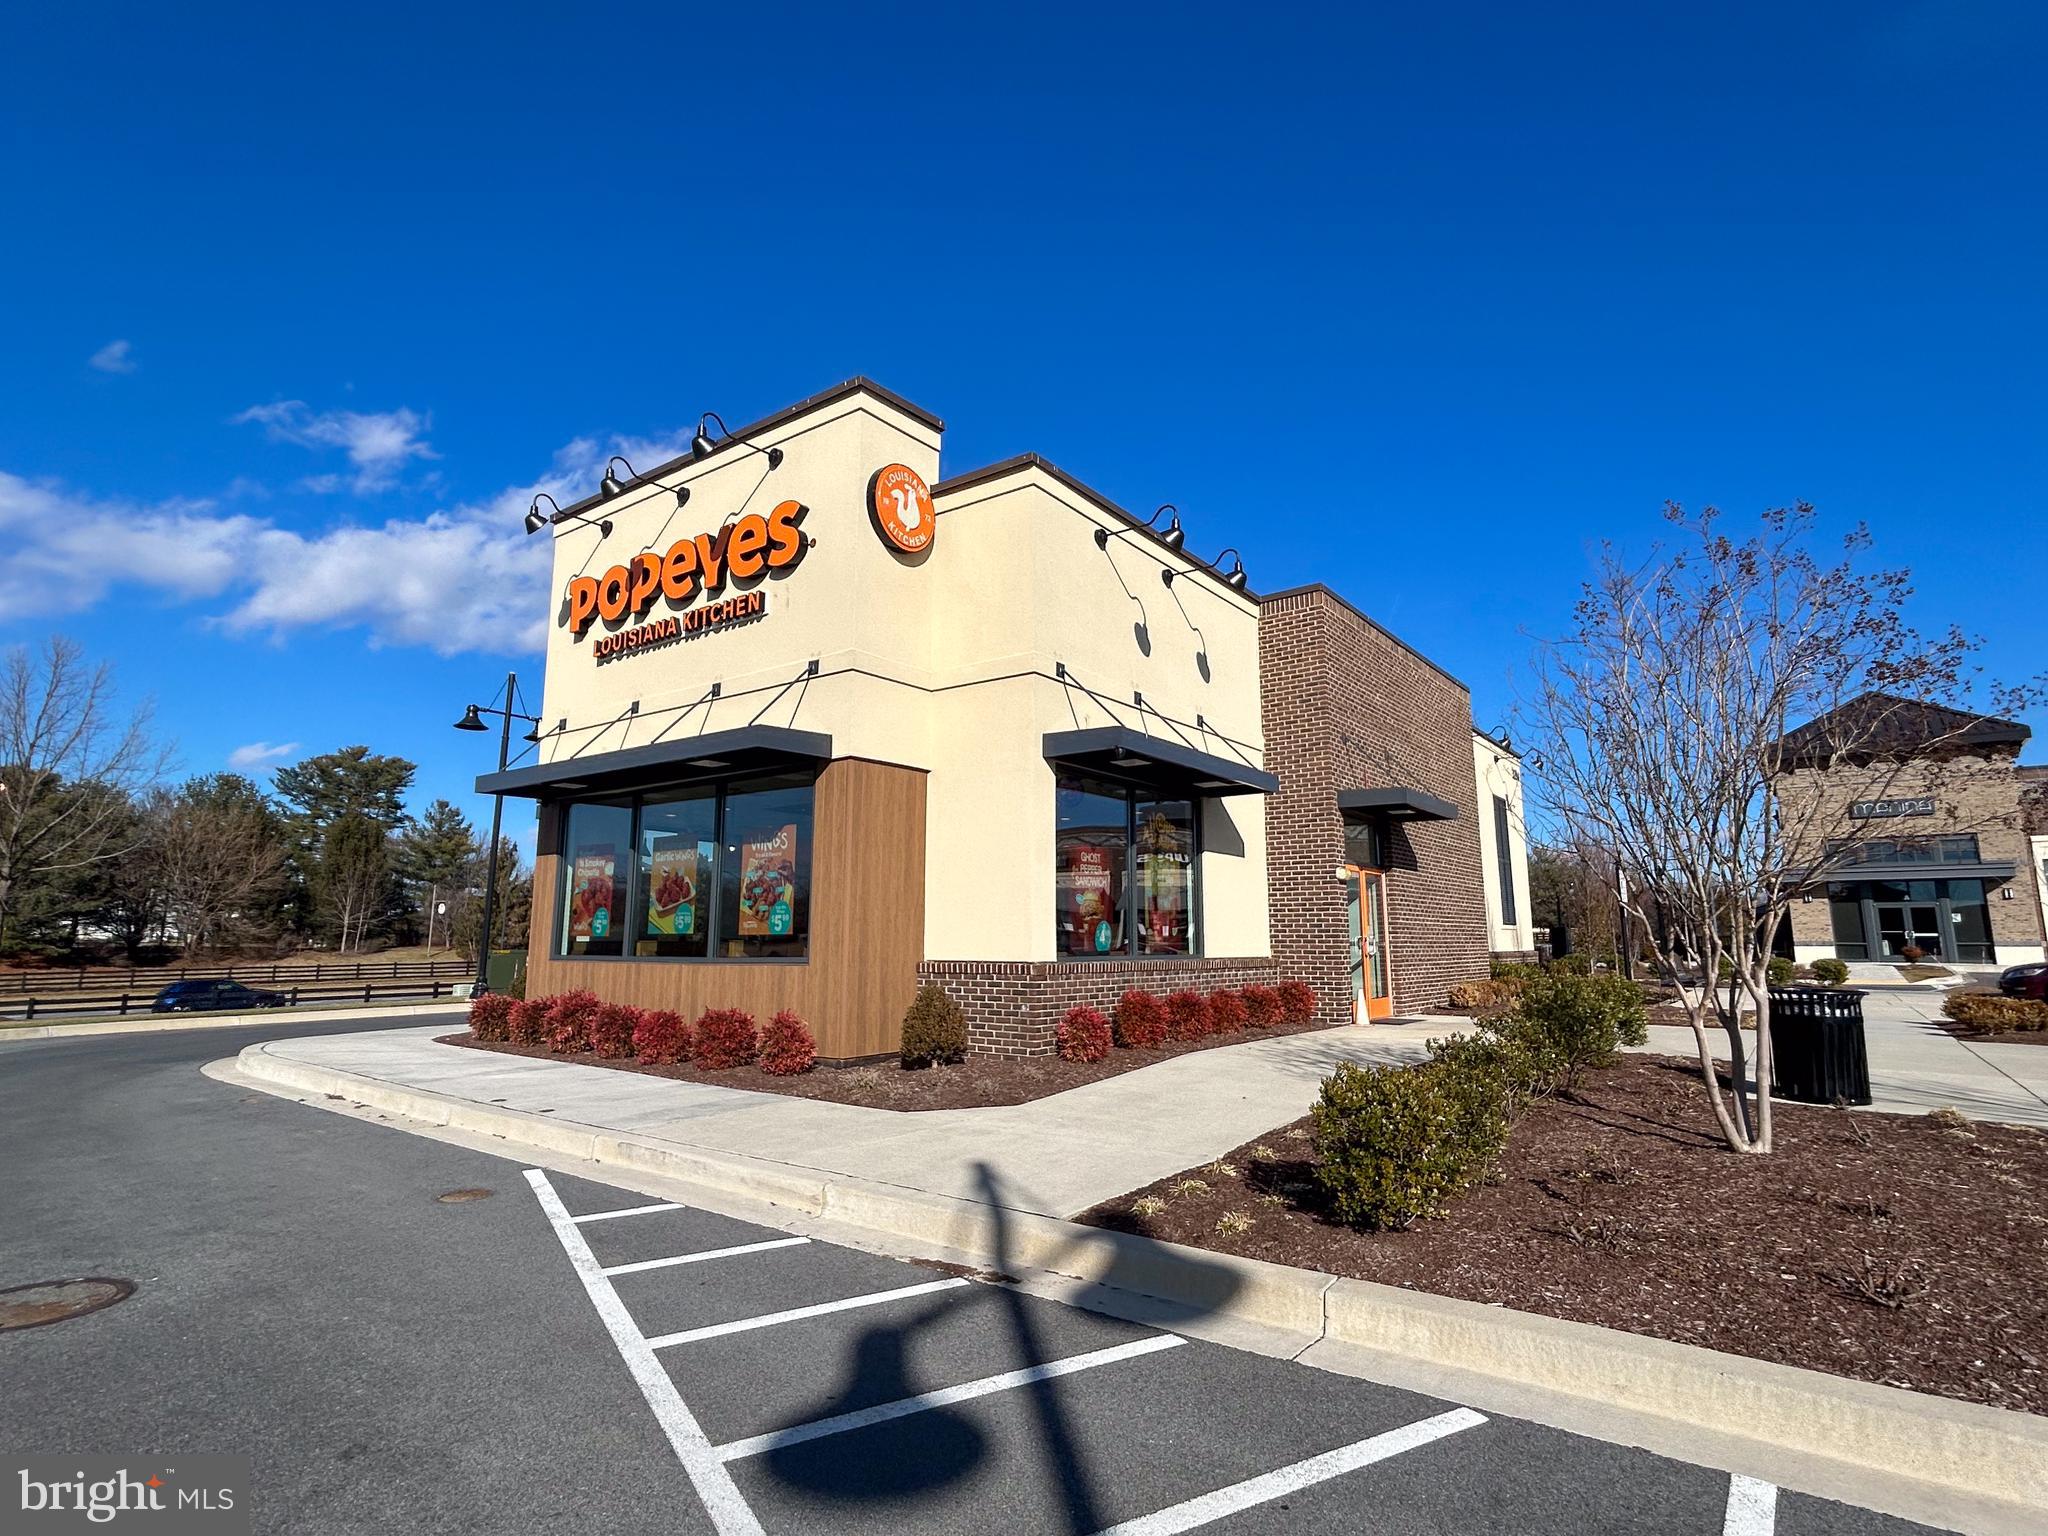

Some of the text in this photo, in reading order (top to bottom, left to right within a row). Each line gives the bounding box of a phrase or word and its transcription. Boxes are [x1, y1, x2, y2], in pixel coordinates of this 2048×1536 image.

[885, 471, 929, 502] LOUISIANA
[887, 521, 927, 546] KITCHEN
[593, 591, 763, 657] LOUISIANA KITCHEN
[1081, 851, 1101, 863] GHOST
[1075, 876, 1107, 887] SANDWICH
